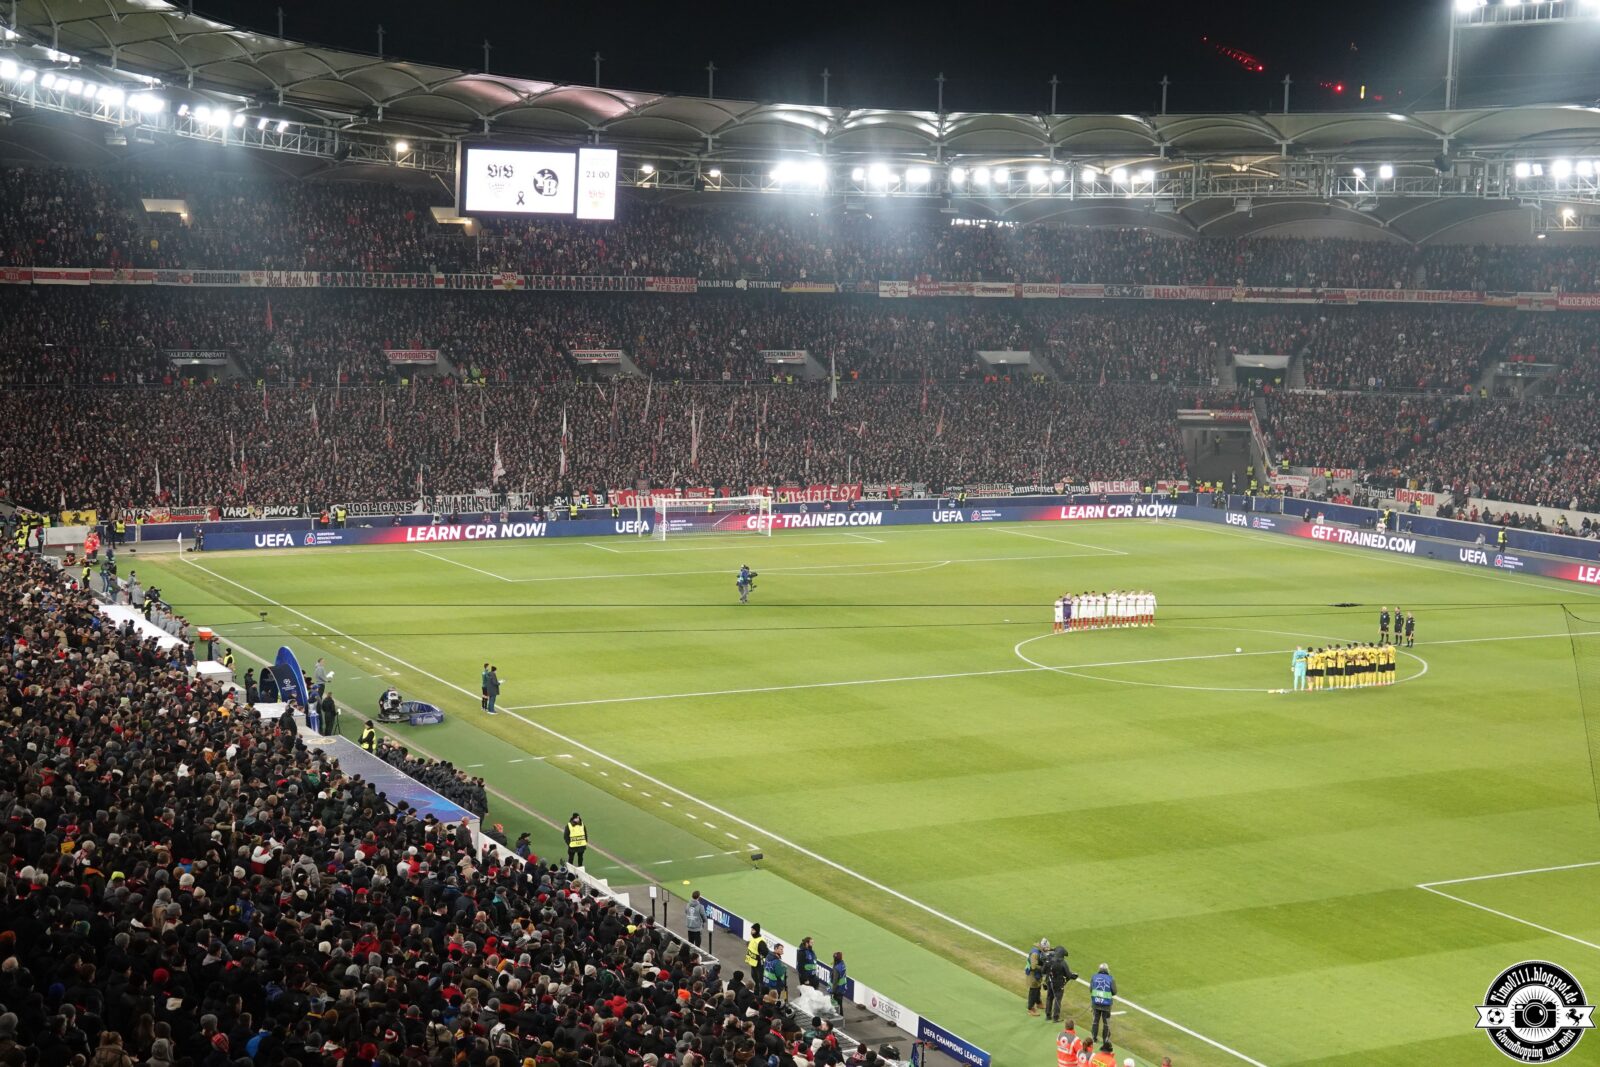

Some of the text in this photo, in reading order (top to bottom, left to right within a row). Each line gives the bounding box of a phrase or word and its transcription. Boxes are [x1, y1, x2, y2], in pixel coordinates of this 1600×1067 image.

[193, 273, 240, 284] BERKHEIM
[320, 273, 493, 289] CANNSTATTER KURVE
[524, 275, 646, 291] NECKARSTADION
[1311, 468, 1353, 480] URACH
[222, 505, 299, 518] YARD BWOYS
[345, 502, 413, 514] HOOLIGANS
[1061, 504, 1178, 519] LEARN CPR NOW!
[747, 512, 882, 529] GET-TRAINED.COM
[933, 510, 963, 522] UEFA
[1226, 512, 1248, 526] UEFA
[406, 523, 546, 542] LEARN CPR NOW!
[616, 521, 649, 533] UEFA
[255, 533, 294, 547] UEFA
[1311, 525, 1417, 554] GET-TRAINED.COM
[1460, 548, 1488, 566] UEFA
[879, 1001, 901, 1019] RESPECT
[923, 1026, 984, 1066] UEFA CHAMPIONS LEAGUE
